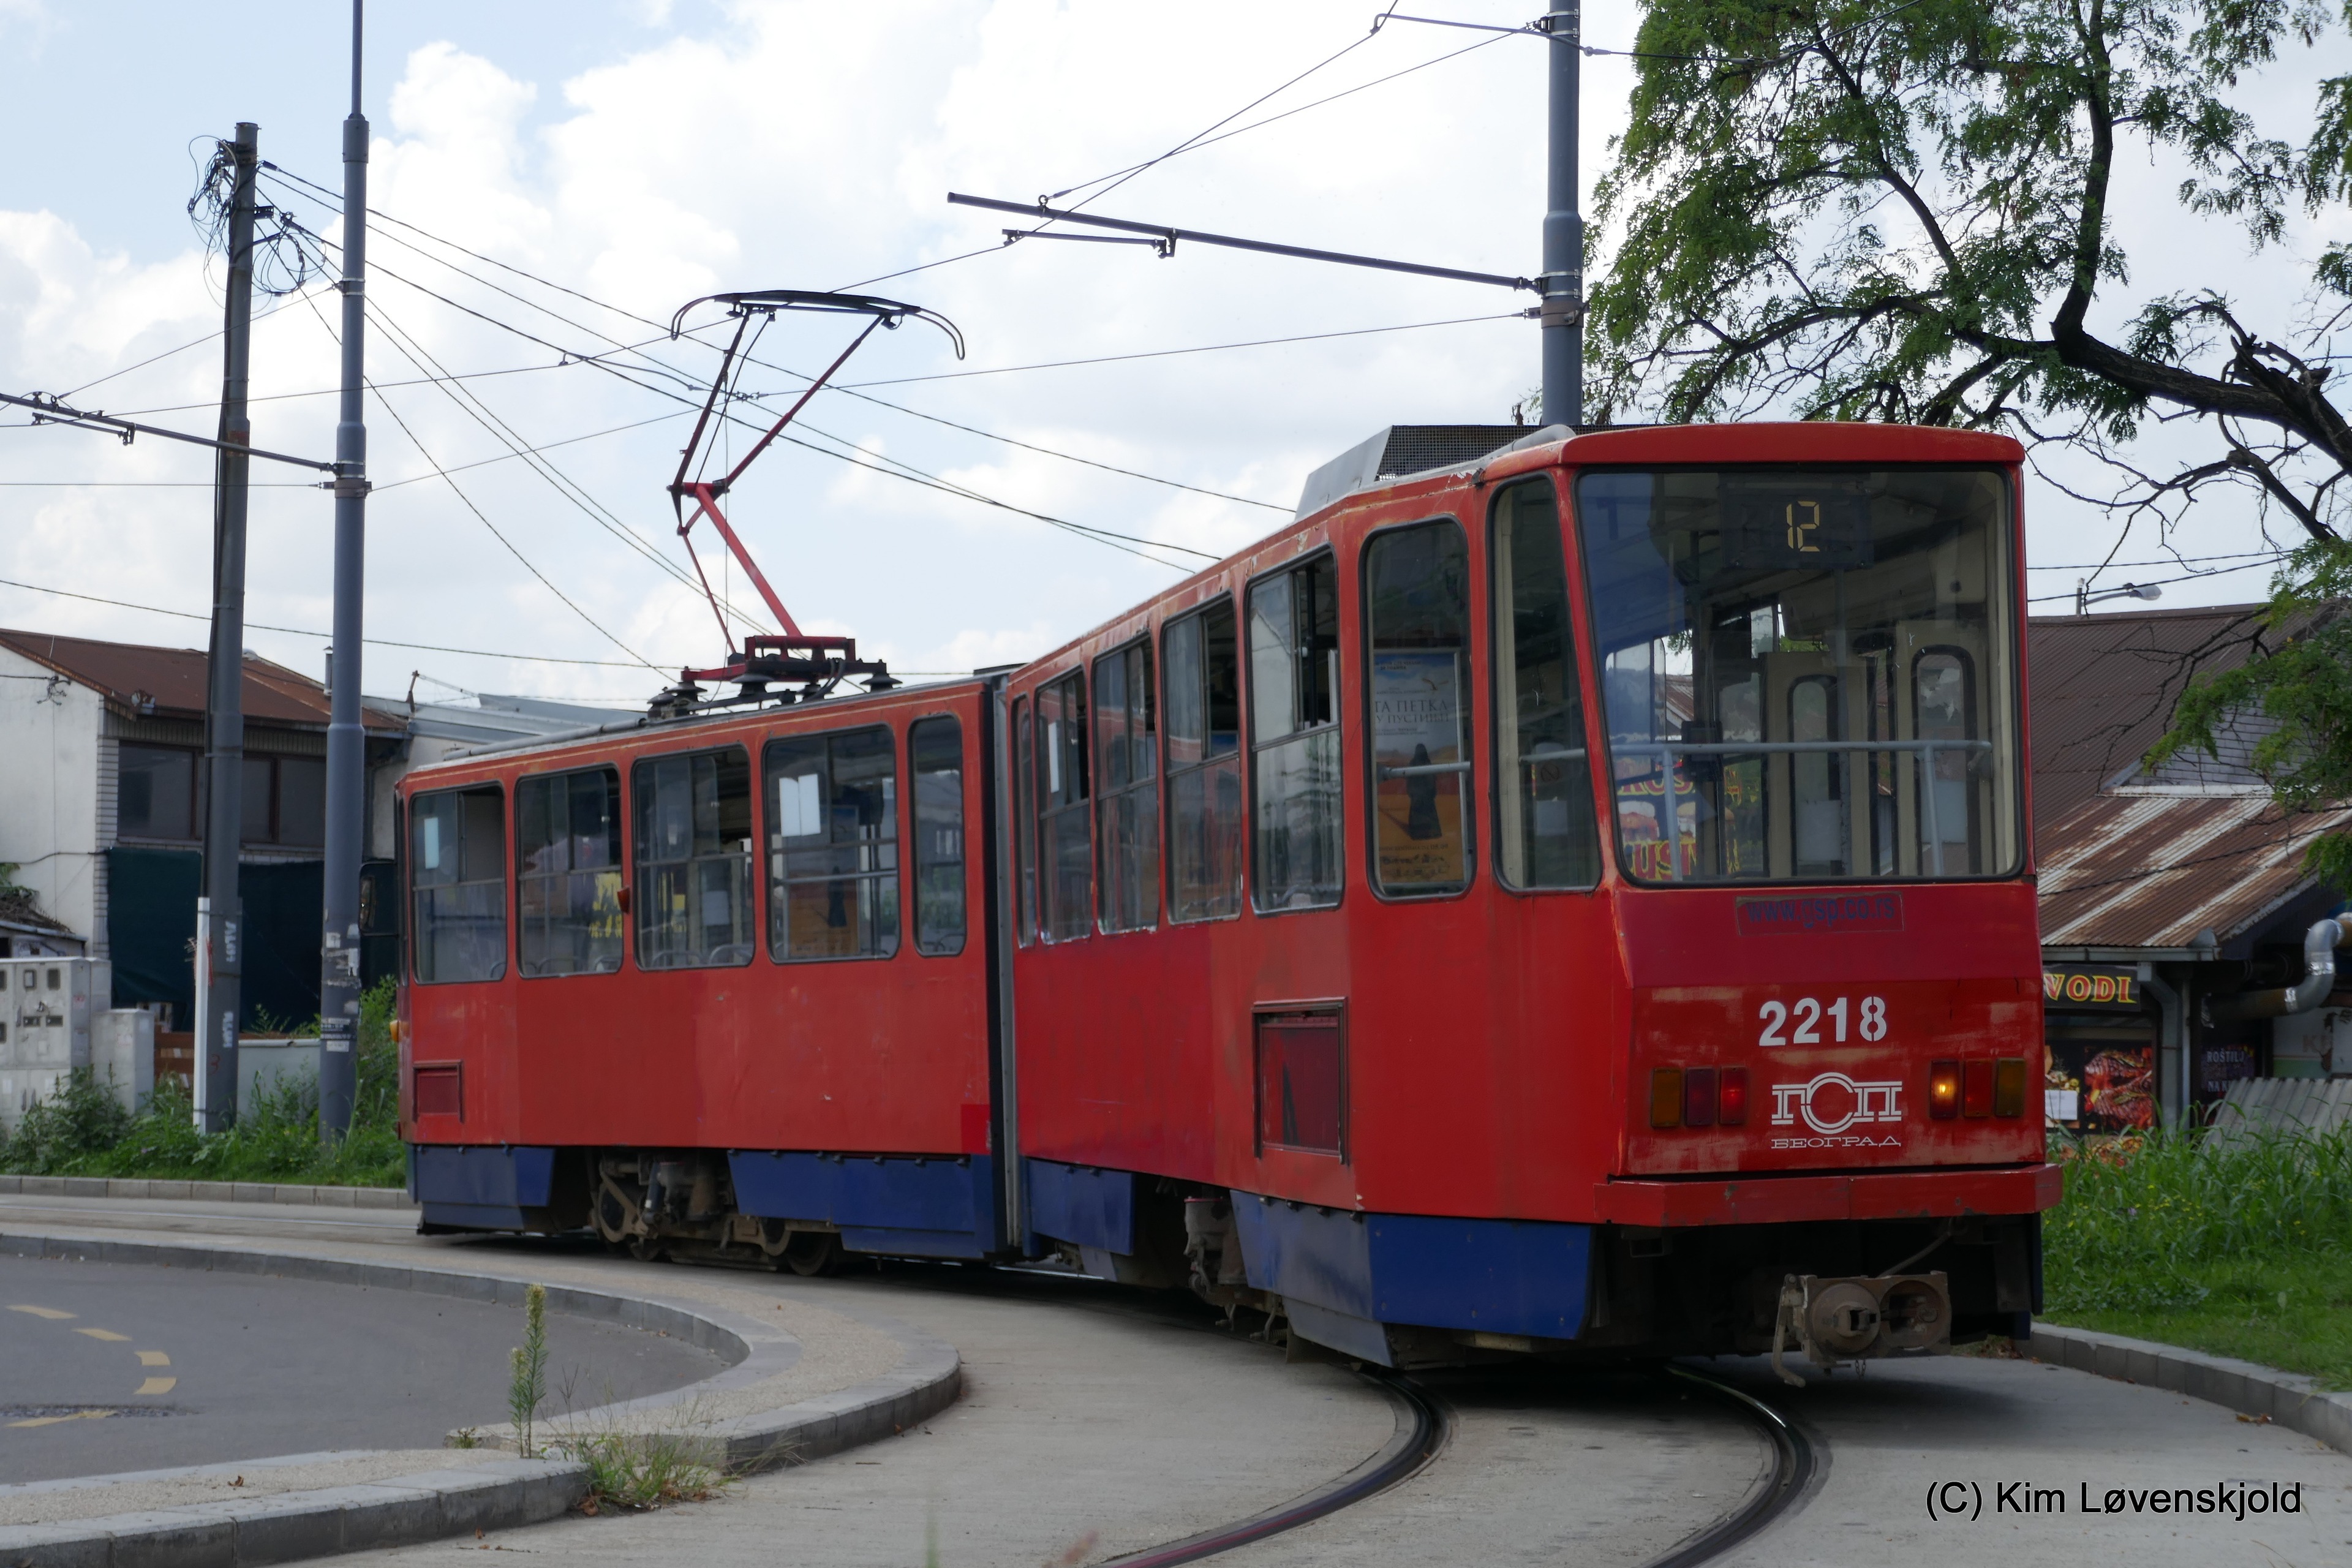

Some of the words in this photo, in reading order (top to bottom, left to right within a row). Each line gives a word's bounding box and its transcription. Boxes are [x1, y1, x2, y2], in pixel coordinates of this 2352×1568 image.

[1786, 501, 1820, 552] 12
[1747, 897, 1895, 929] www.gsp.co.rs
[2043, 973, 2137, 1003] VODI
[1759, 997, 1887, 1046] 2218
[1771, 1072, 1902, 1134] ГСП
[1771, 1136, 1901, 1149] БЕОГРАД
